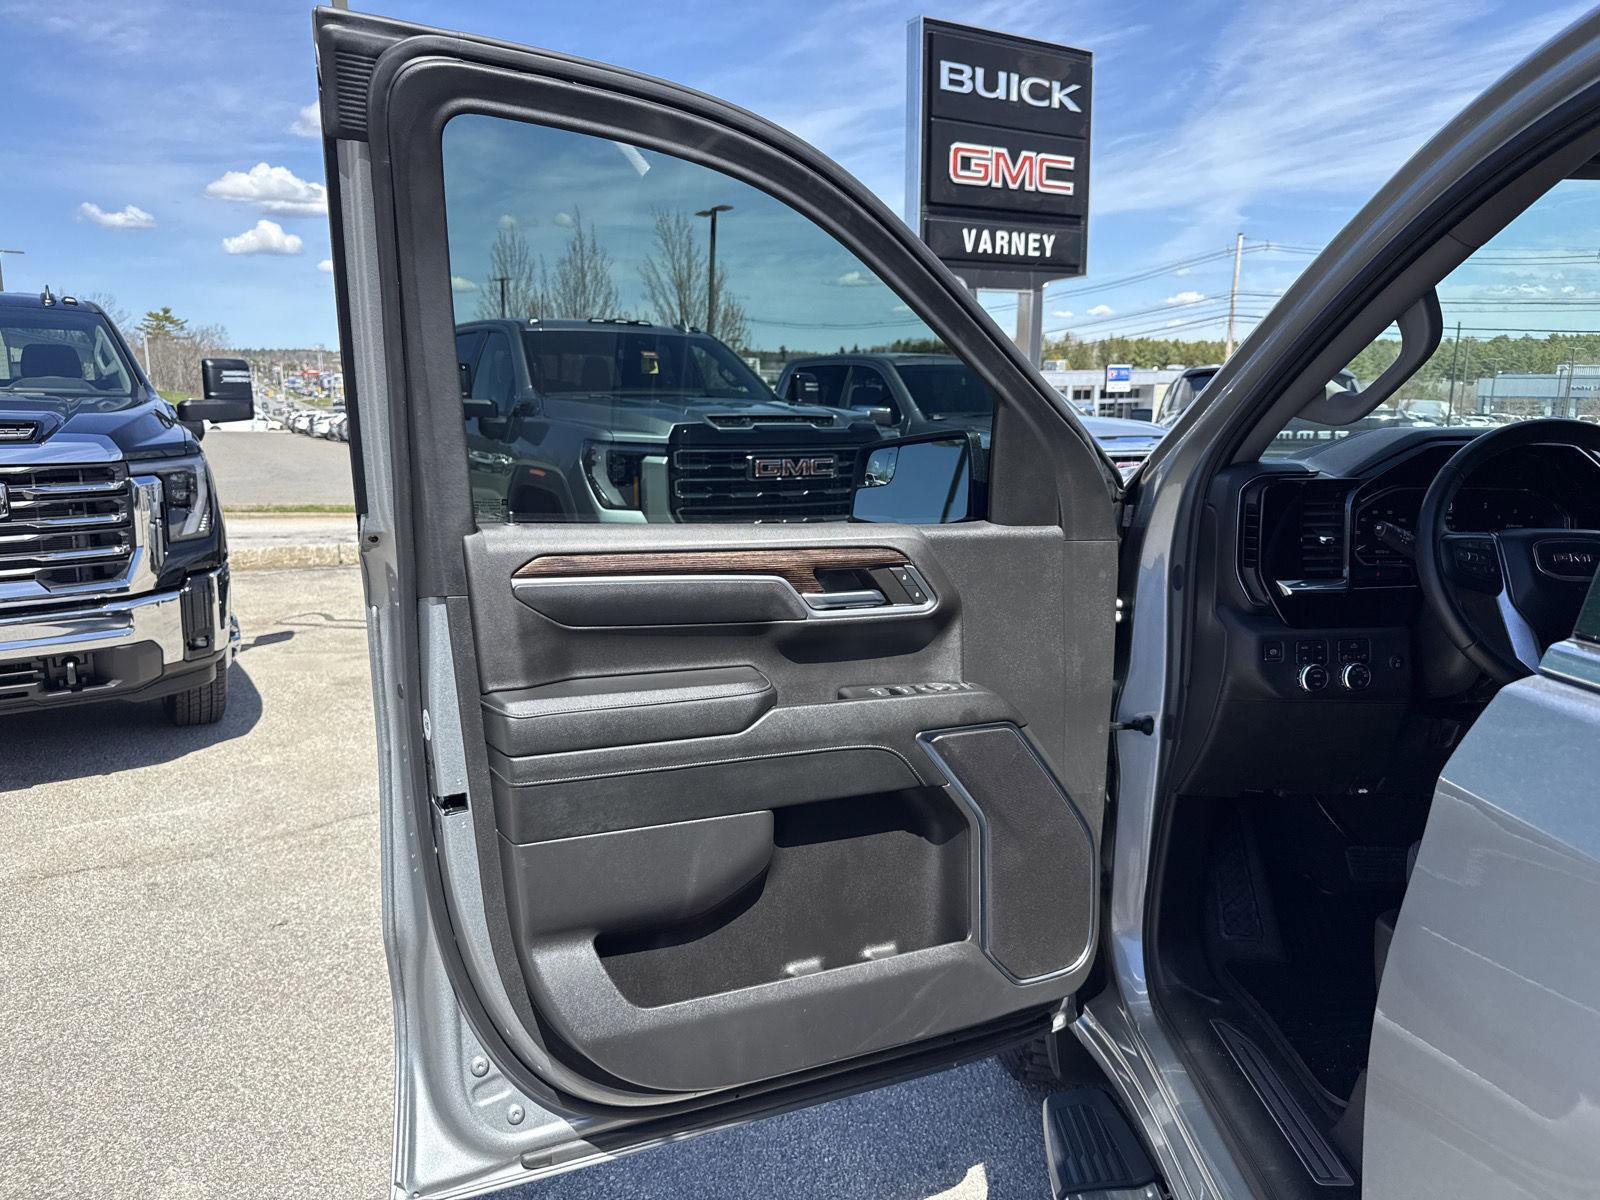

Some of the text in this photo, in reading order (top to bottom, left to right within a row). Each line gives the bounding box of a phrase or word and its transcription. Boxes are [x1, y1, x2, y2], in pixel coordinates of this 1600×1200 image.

[939, 60, 1082, 112] BUICK
[949, 141, 1075, 195] GMC
[962, 228, 1056, 257] VARNEY
[1276, 430, 1350, 440] MMER
[755, 459, 834, 477] GMC
